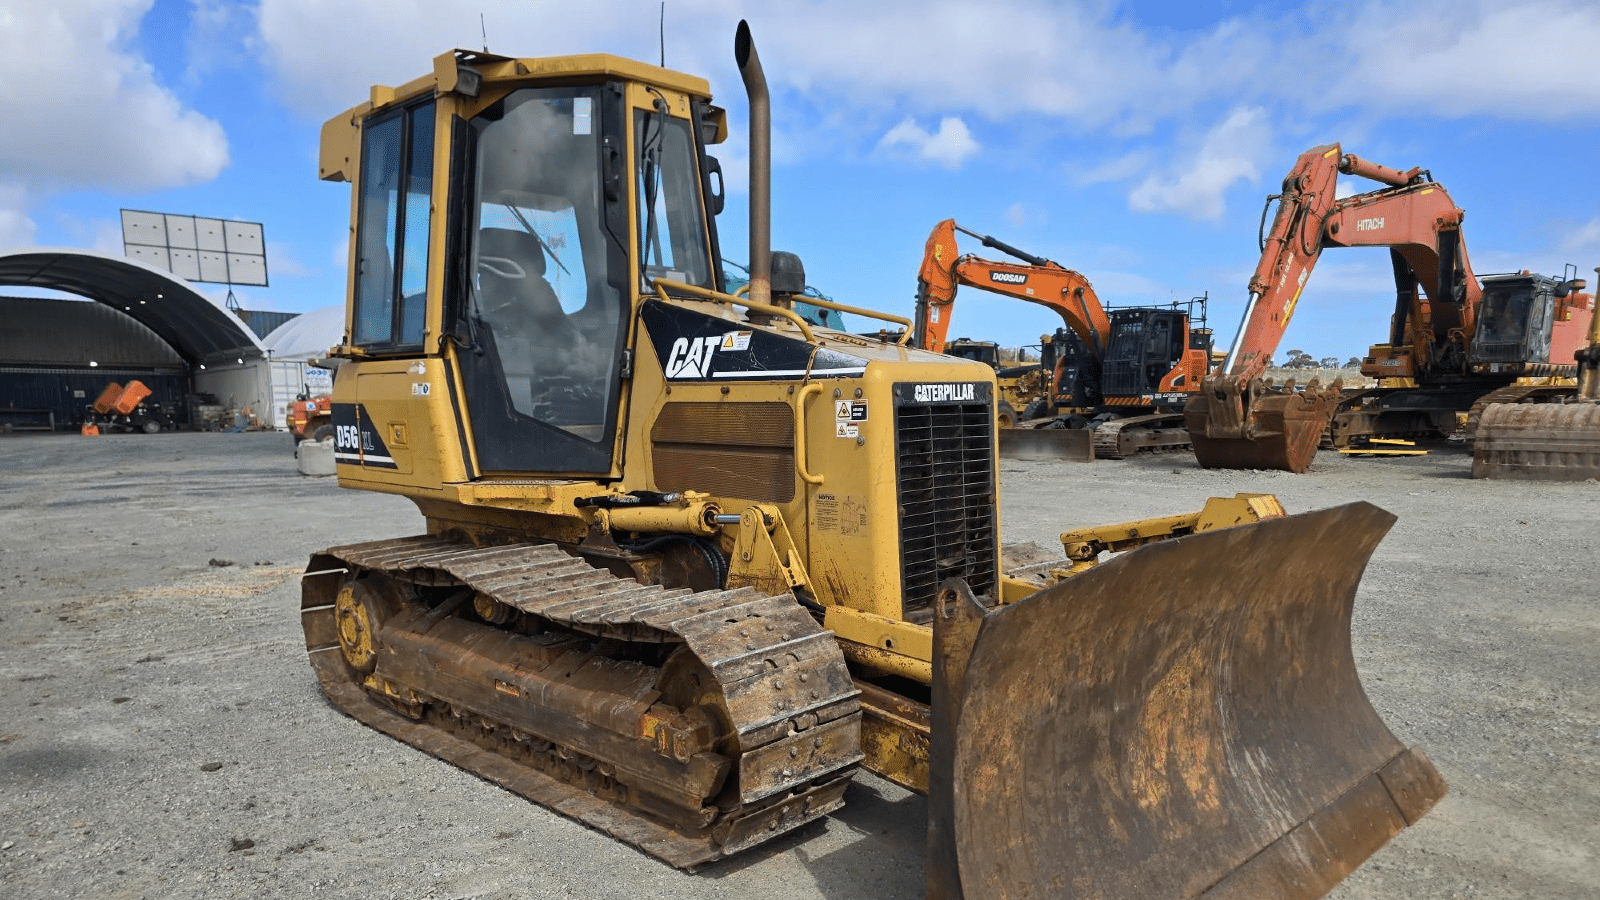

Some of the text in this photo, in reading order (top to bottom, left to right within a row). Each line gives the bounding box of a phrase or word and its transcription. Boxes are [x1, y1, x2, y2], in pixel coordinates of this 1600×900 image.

[1356, 217, 1385, 231] HITACHI
[992, 272, 1026, 283] DOOSAN
[665, 335, 722, 378] CAT
[914, 383, 974, 402] CATERPILLAR
[336, 424, 359, 449] D5G
